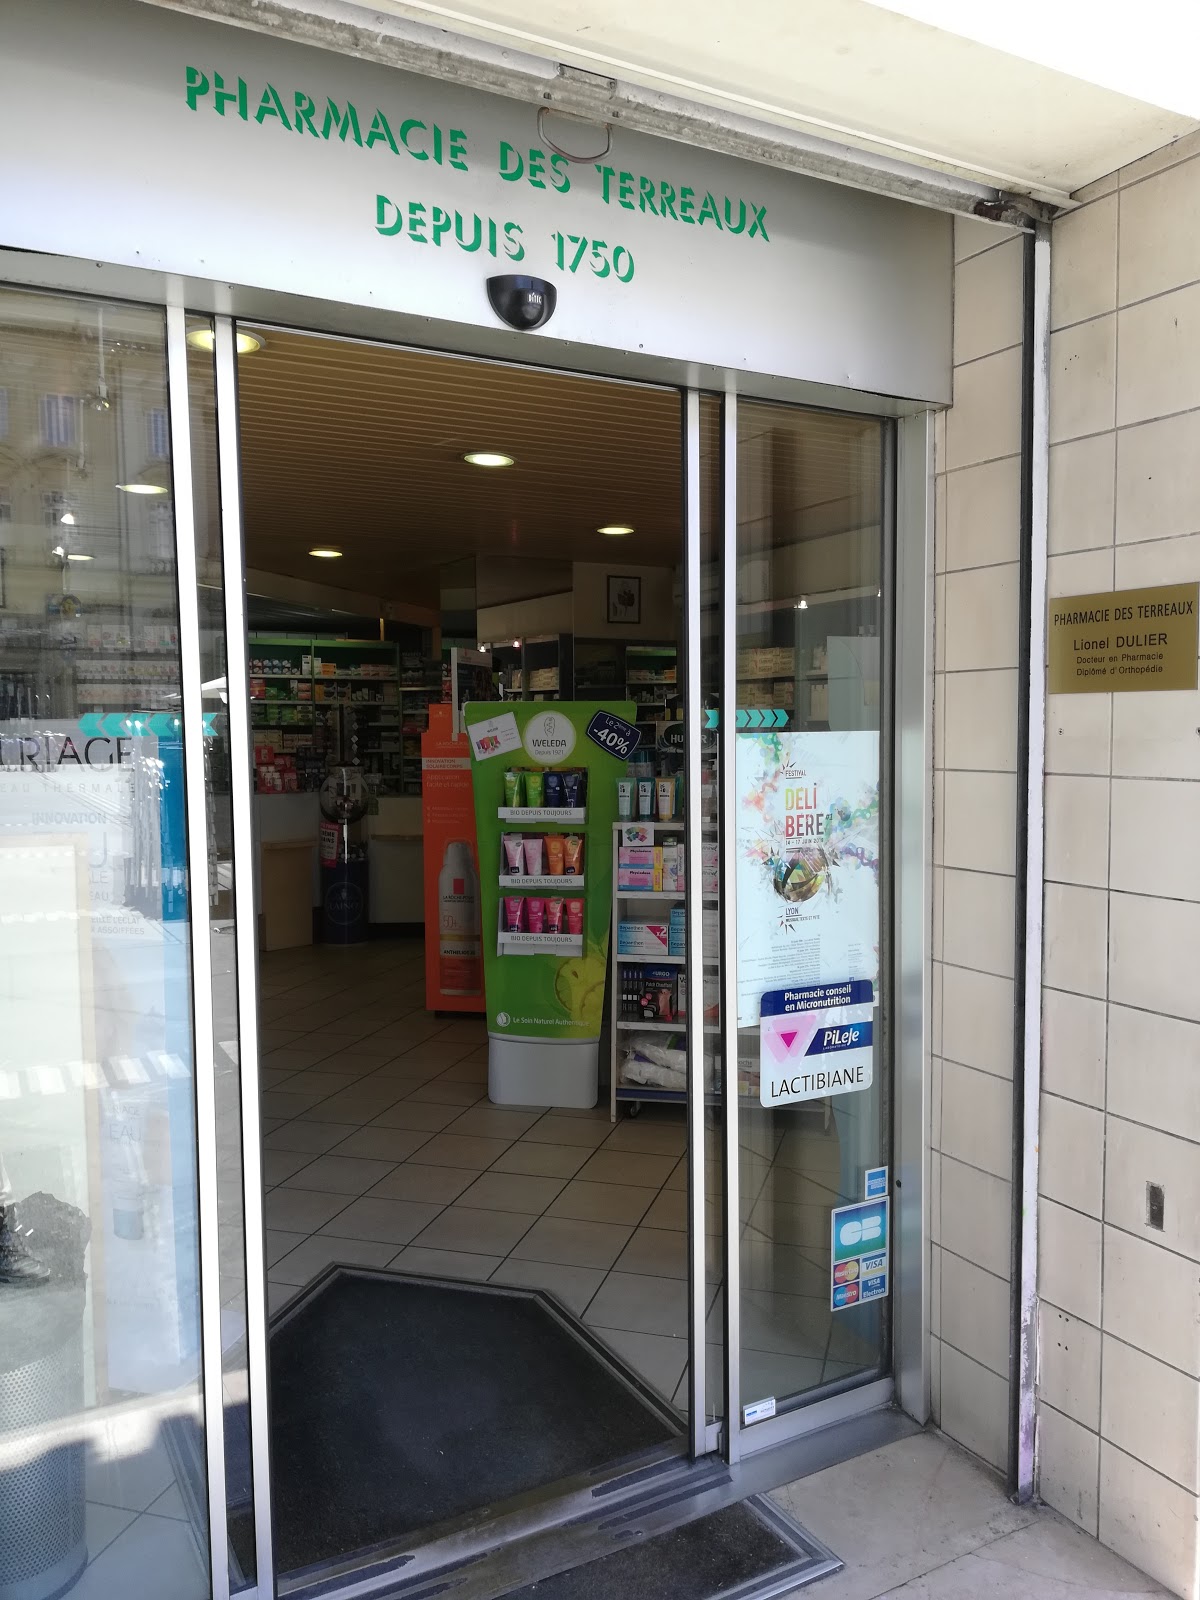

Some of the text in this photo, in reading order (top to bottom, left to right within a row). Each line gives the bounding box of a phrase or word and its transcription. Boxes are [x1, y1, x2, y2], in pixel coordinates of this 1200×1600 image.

[185, 66, 770, 242] PHARMACIE DES TERREAUX
[375, 194, 635, 283] DEPUIS 1750
[1054, 601, 1193, 626] PHARMACIE DES TERREAUX
[1074, 633, 1168, 651] Lionel DULIER
[1077, 656, 1105, 666] Docteur
[1122, 652, 1164, 662] Pharmacie
[1077, 667, 1107, 678] Diplômé
[1119, 664, 1164, 675] Orthopédie
[532, 739, 567, 748] WELEDA
[593, 728, 630, 755] -40%
[785, 769, 806, 777] FESTIVAL
[785, 906, 799, 916] LYON
[785, 984, 852, 1002] Pharmacie conseil
[785, 996, 851, 1012] en Micronutrition
[824, 1028, 860, 1047] PiLeJe
[771, 1066, 864, 1098] LACTIBIANE
[840, 1215, 882, 1246] CB
[865, 1259, 883, 1271] VISA
[836, 1278, 881, 1300] Maestro VISA
[863, 1288, 885, 1299] Electron
